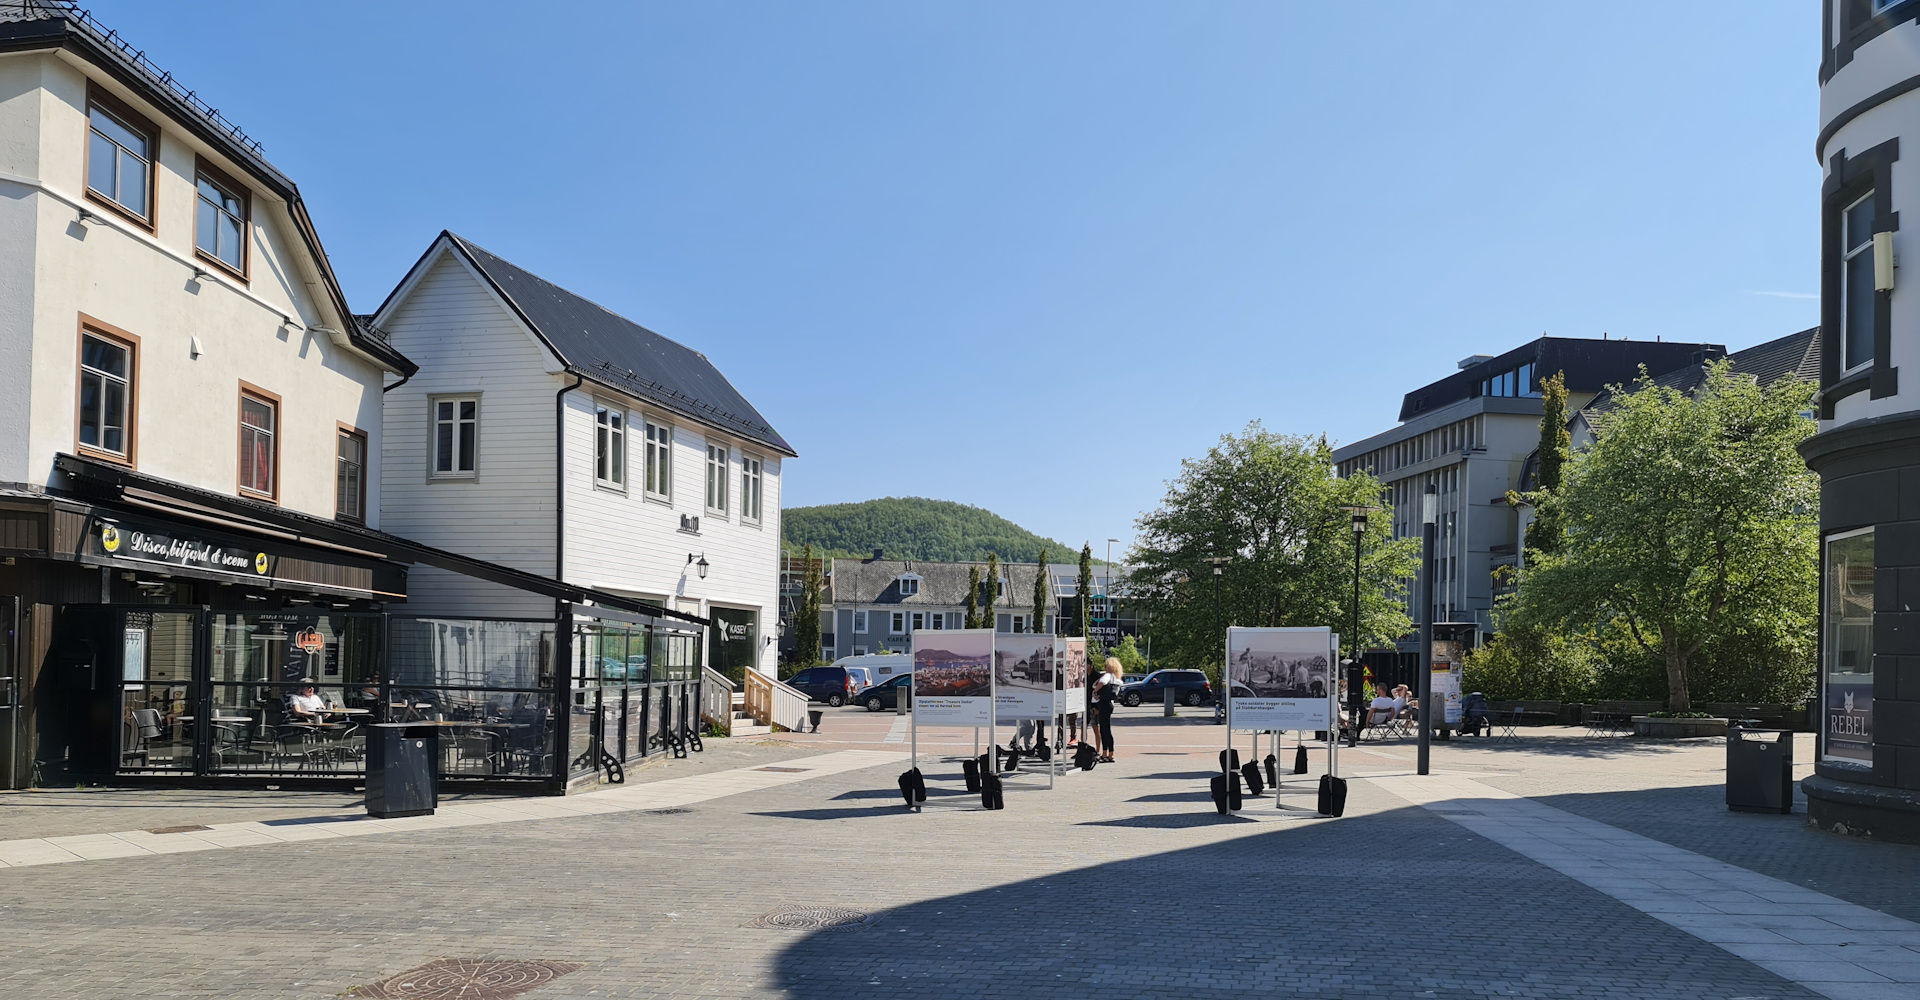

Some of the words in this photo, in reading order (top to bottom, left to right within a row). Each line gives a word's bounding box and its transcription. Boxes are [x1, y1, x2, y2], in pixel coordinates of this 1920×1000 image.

[211, 548, 221, 564] &
[222, 553, 248, 568] scene
[730, 624, 747, 635] KASEY
[1831, 714, 1869, 736] REBEL
